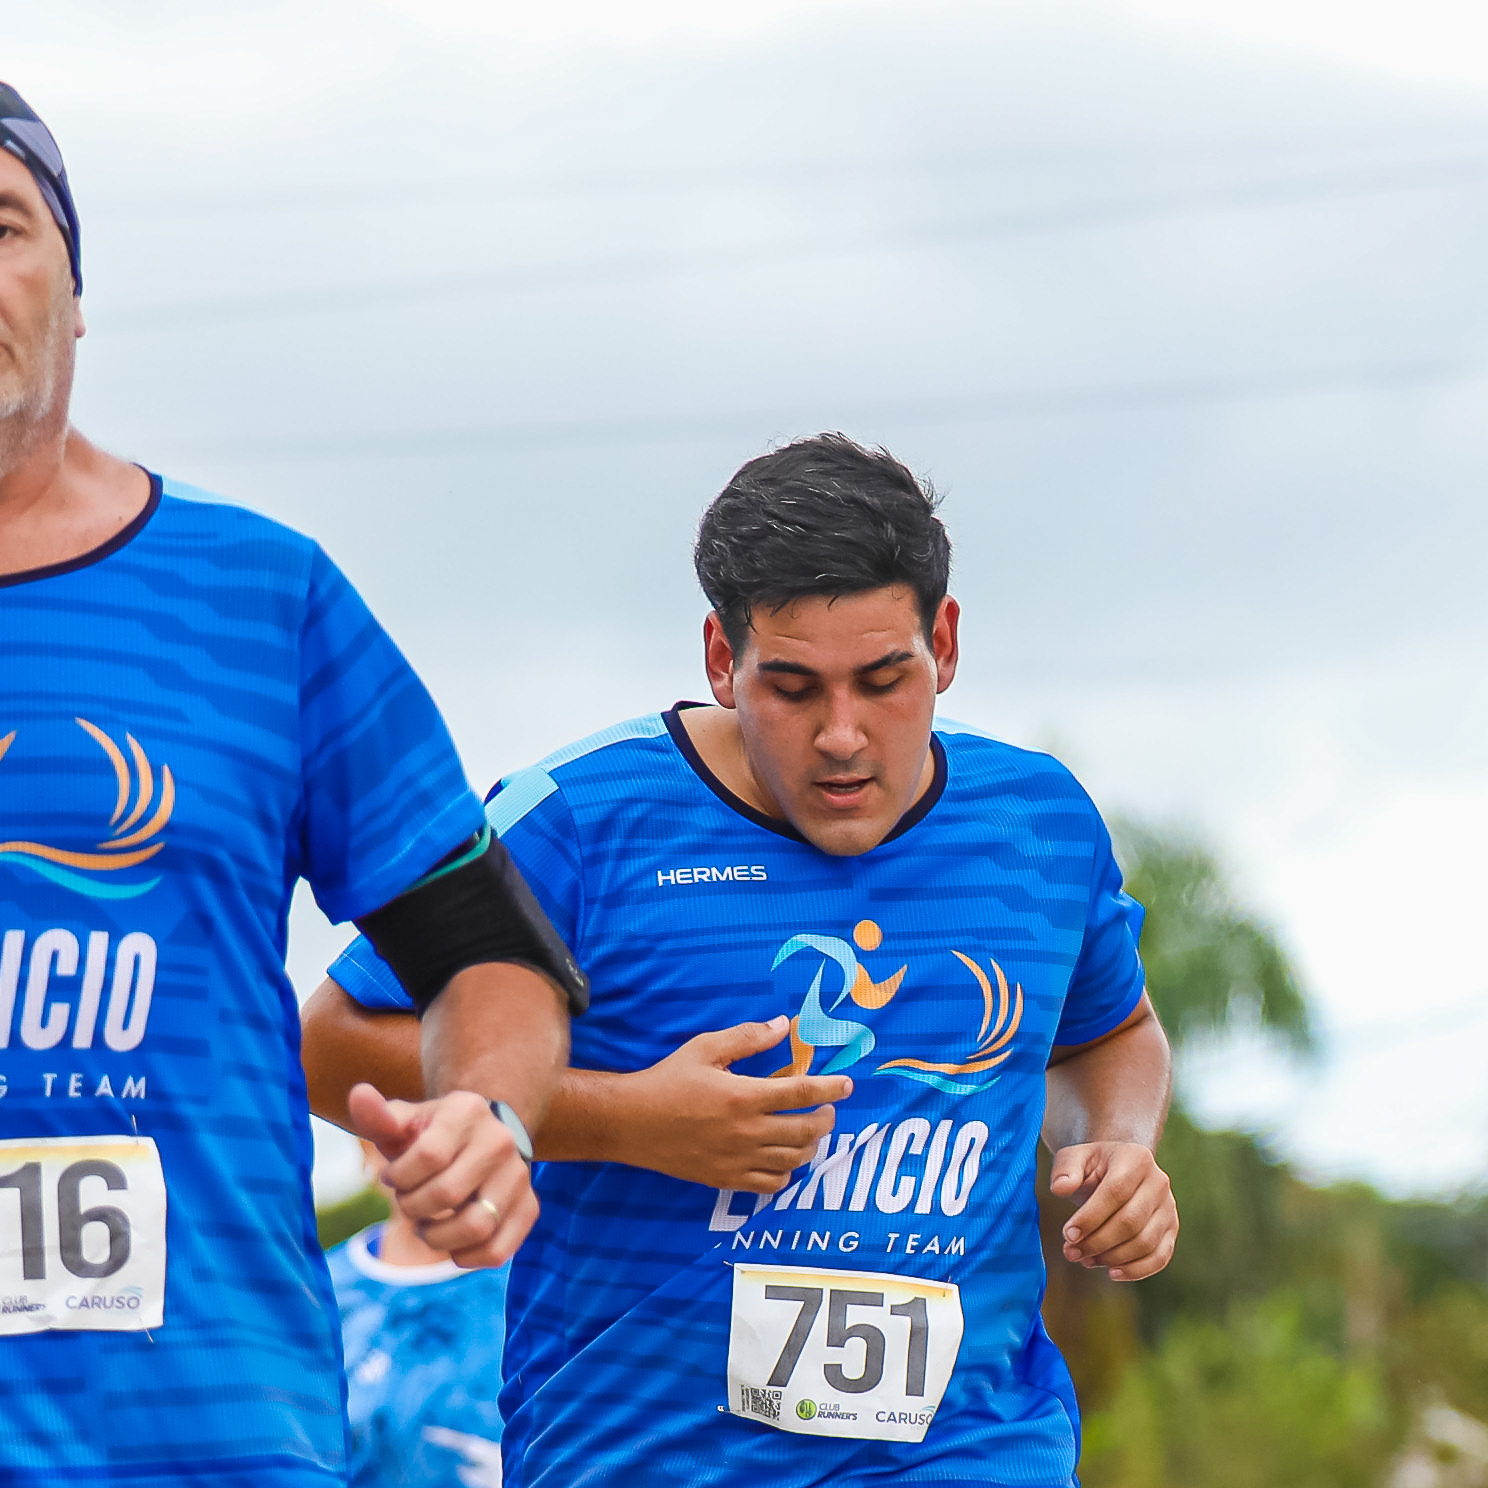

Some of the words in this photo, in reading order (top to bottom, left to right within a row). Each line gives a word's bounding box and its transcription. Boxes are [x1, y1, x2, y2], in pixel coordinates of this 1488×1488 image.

[657, 865, 767, 886] HERMES
[43, 1073, 146, 1099] TEAM
[713, 1229, 860, 1252] NNING
[886, 1233, 965, 1256] TEAM
[65, 1295, 141, 1310] CARUSO
[765, 1284, 929, 1397] 751
[819, 1402, 840, 1411] CLUB
